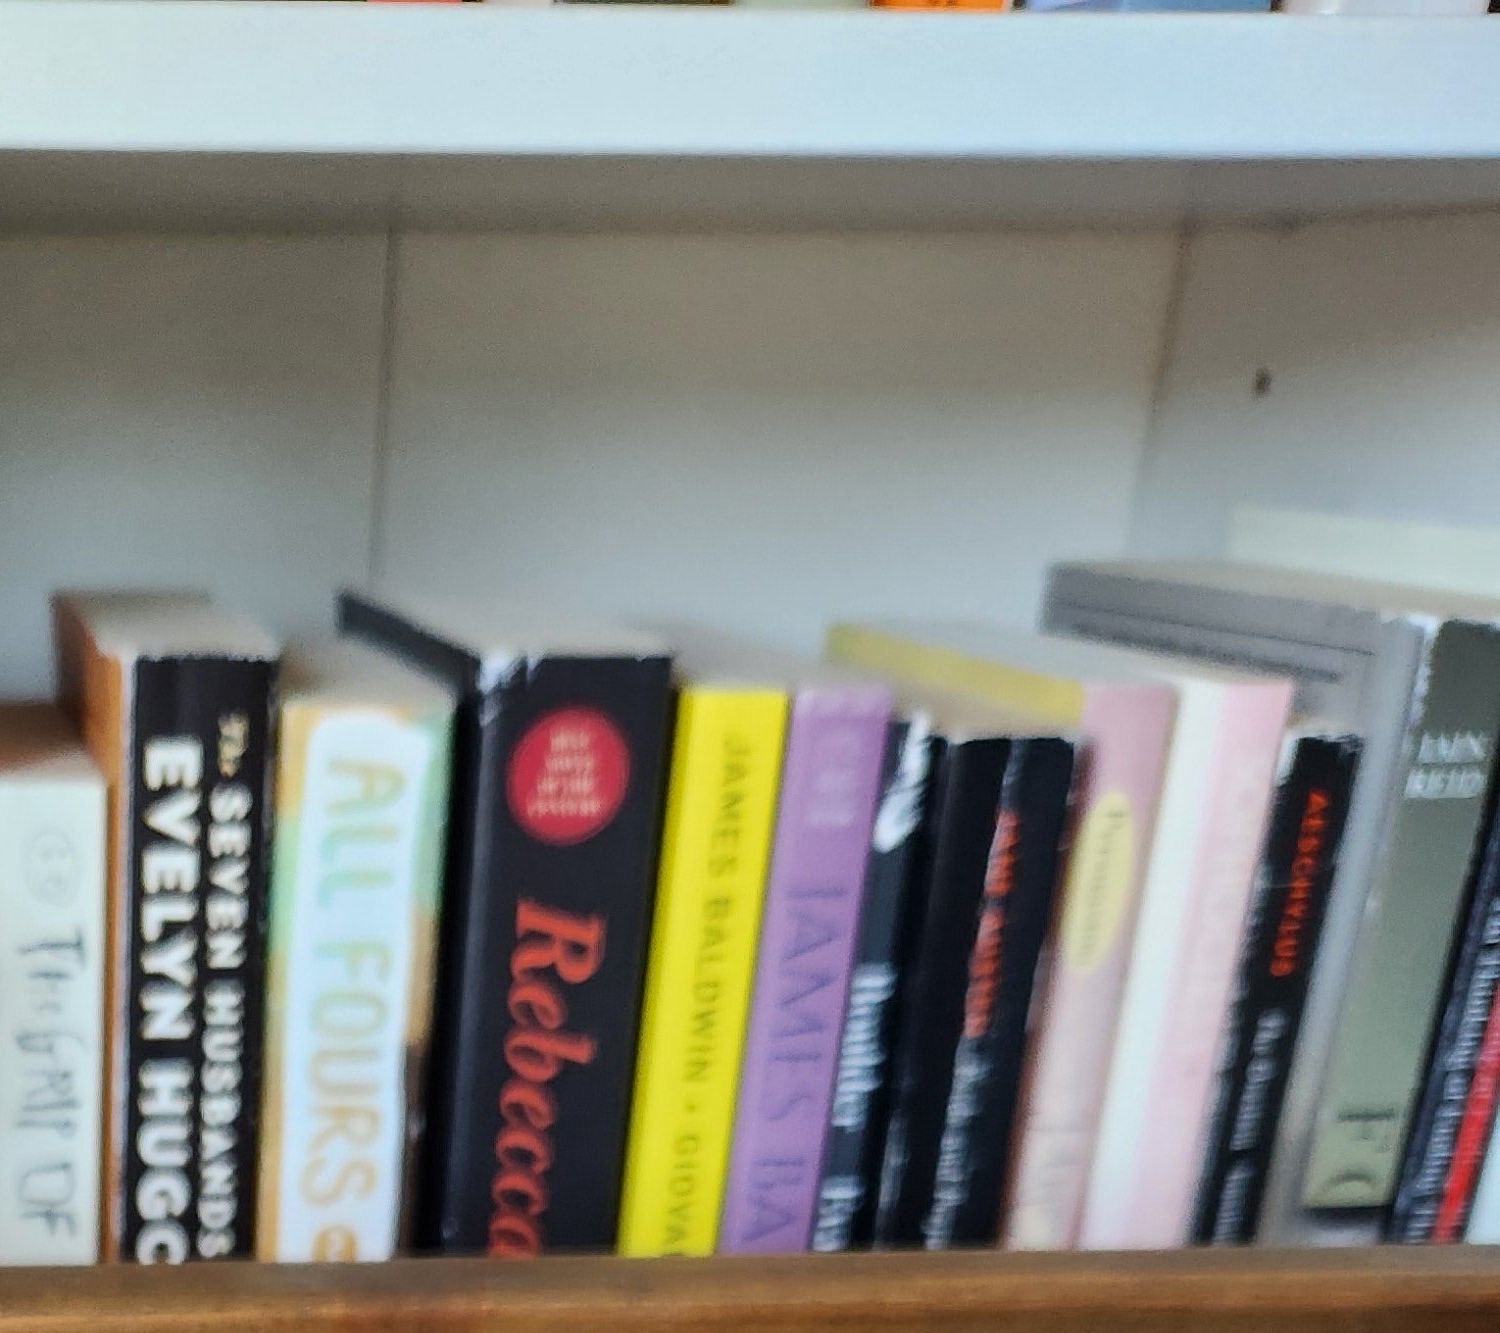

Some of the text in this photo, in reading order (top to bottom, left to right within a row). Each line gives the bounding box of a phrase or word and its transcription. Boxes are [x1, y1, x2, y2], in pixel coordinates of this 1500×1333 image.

[137, 733, 205, 1042] EVELYN
[205, 780, 253, 971] SEVEN
[301, 754, 409, 1210] ALL FOURS
[662, 730, 752, 1256] JAMES BALDWIN GIOVA
[196, 977, 244, 1259] HUSBANDS
